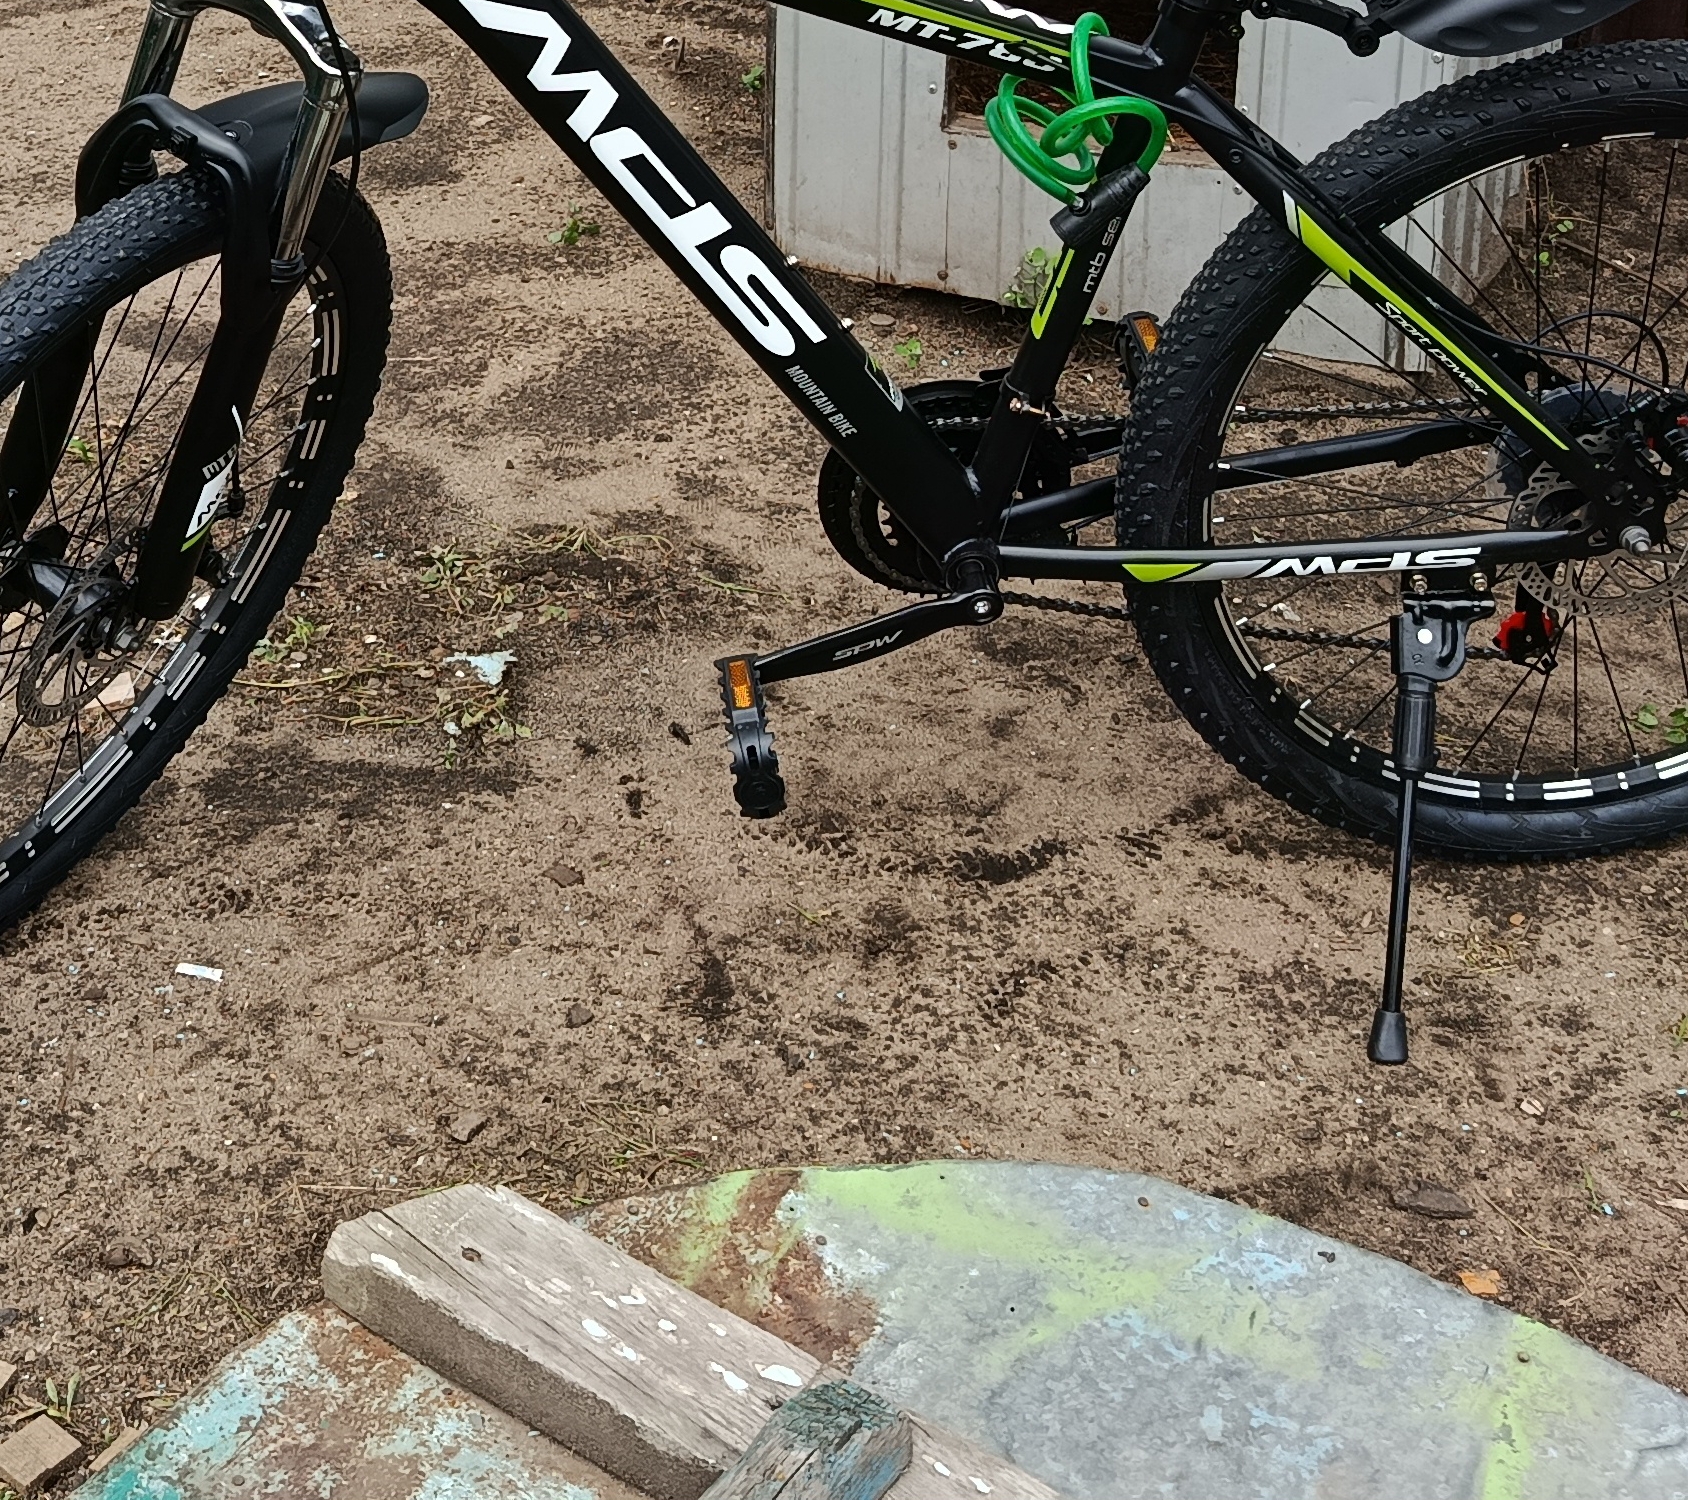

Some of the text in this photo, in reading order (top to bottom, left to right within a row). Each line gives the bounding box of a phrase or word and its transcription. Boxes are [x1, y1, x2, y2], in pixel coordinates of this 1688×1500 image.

[1375, 301, 1488, 396] Sport power
[784, 364, 858, 438] MOUNTAIN BIKE
